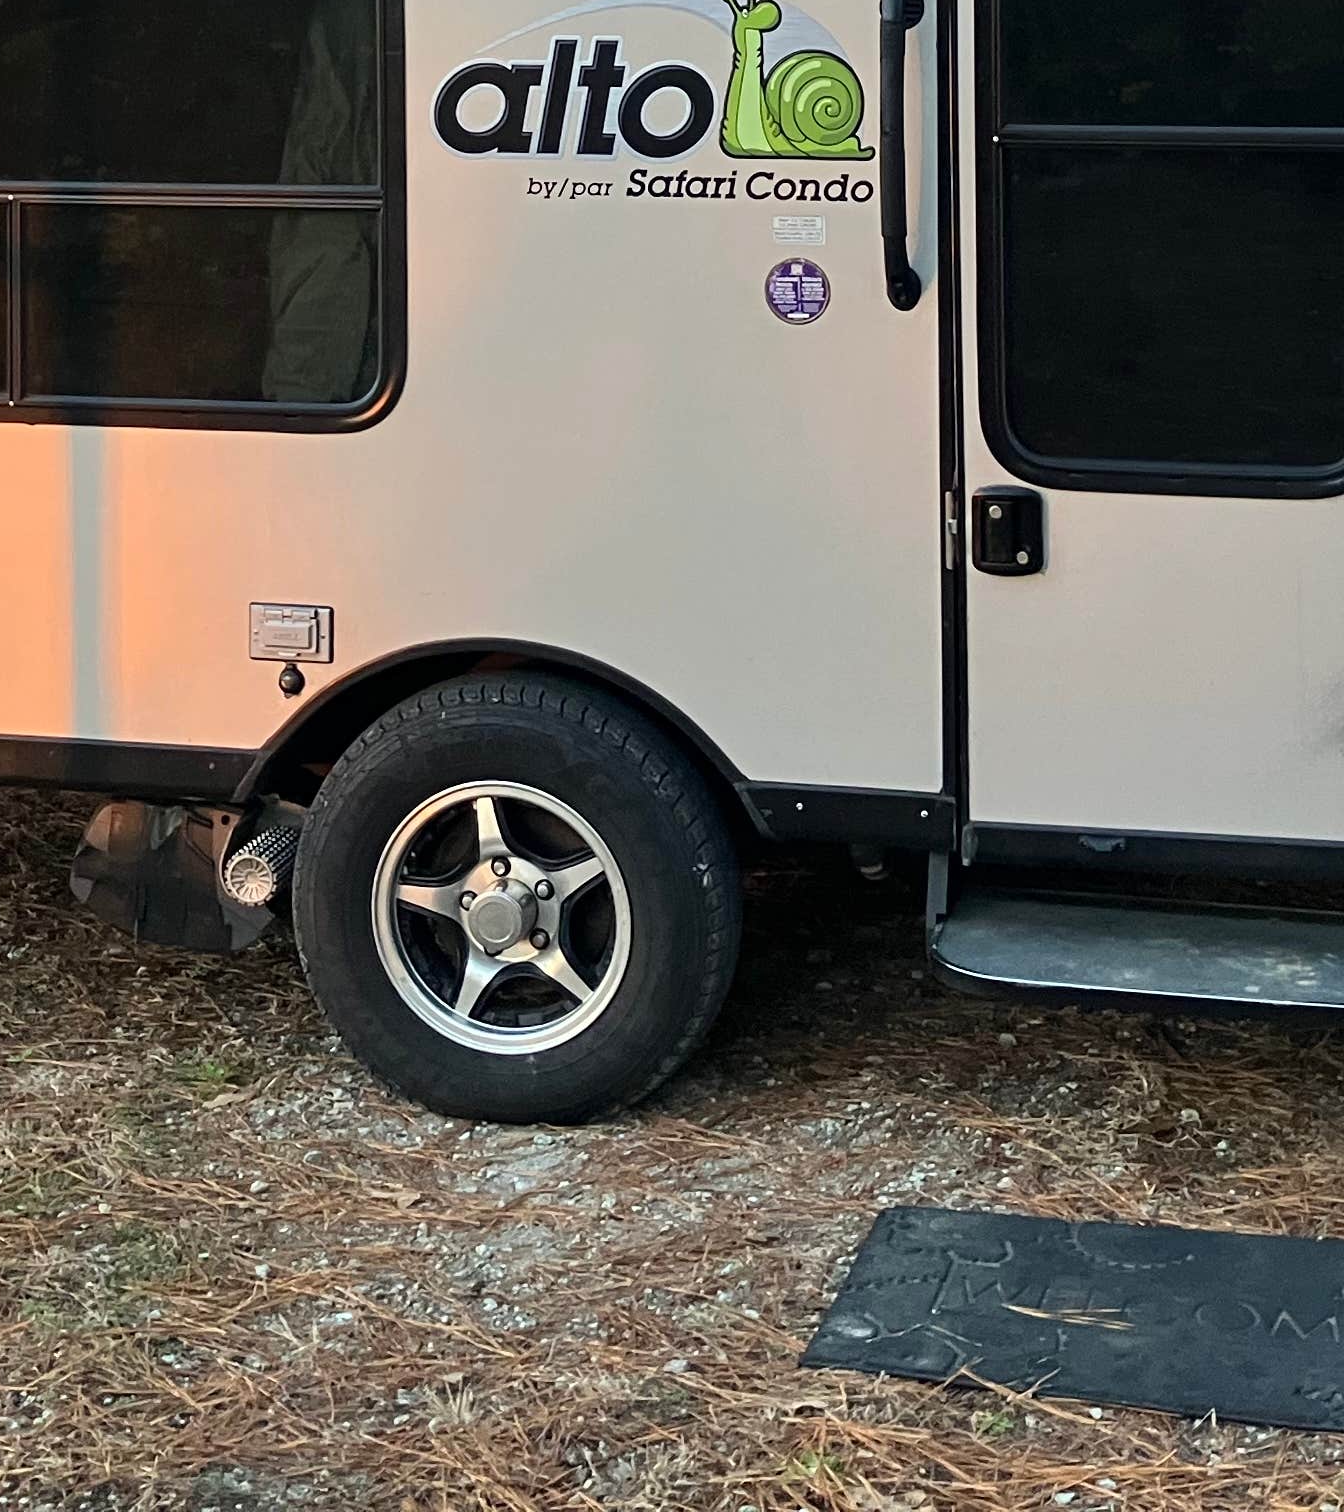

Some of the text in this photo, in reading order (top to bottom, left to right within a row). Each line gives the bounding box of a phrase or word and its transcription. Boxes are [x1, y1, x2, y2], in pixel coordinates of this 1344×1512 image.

[434, 39, 714, 158] alto
[625, 168, 737, 199] Safari
[745, 171, 874, 202] Condo
